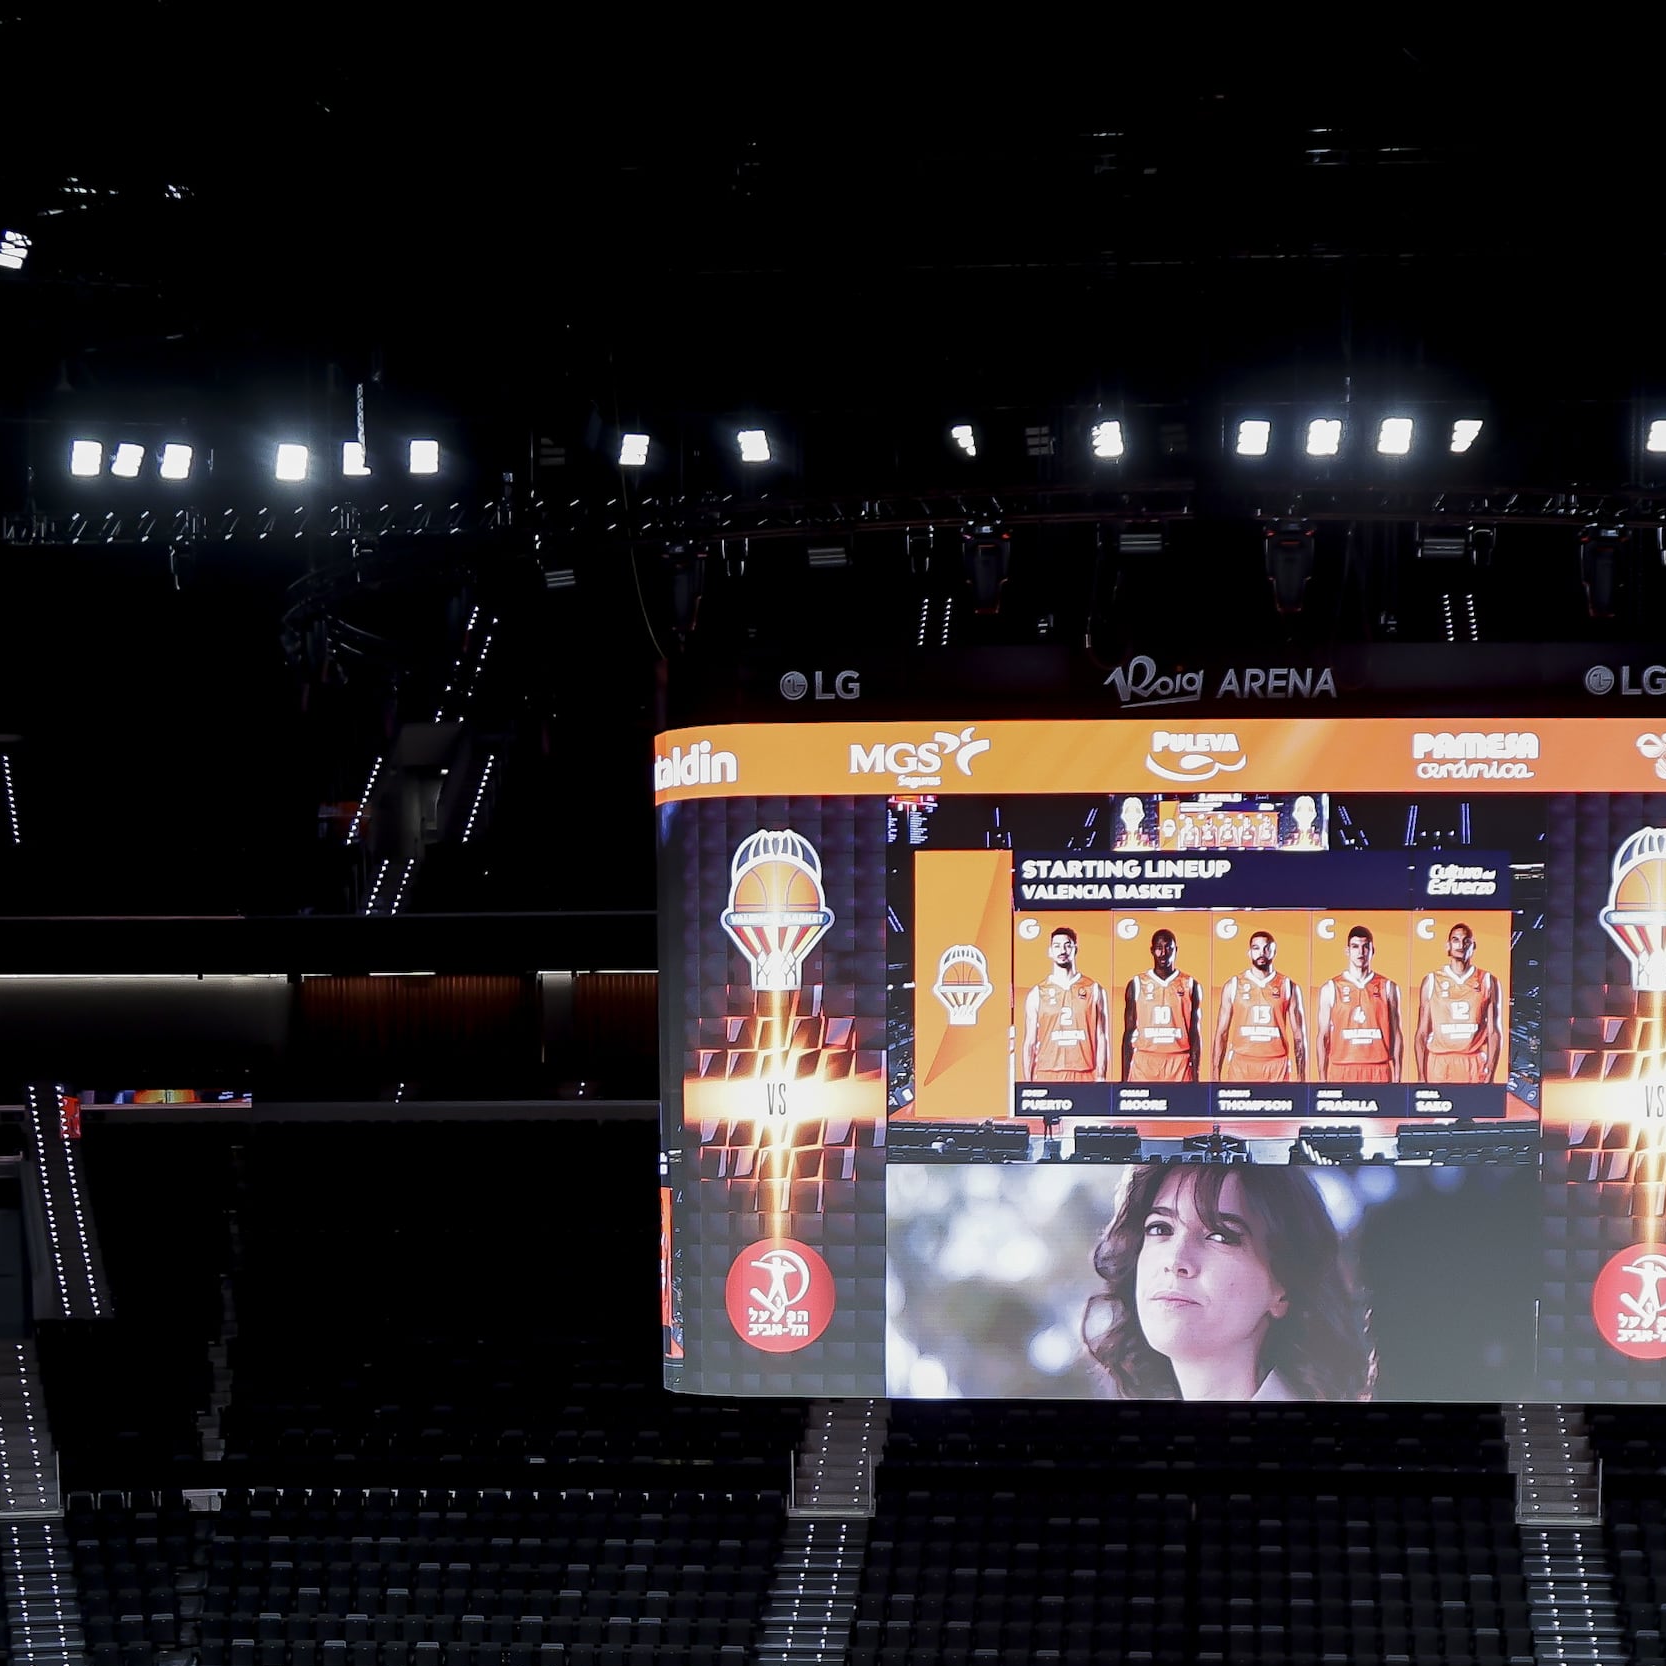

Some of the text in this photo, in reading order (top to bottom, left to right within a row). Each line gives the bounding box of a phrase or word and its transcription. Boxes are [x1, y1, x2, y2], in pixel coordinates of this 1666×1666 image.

[815, 670, 861, 700] LG
[1103, 655, 1337, 706] Roig ARENA
[1152, 731, 1240, 752] PULEVA
[1412, 732, 1539, 759] PAMESA
[849, 742, 942, 774] MGS
[1022, 859, 1231, 880] STARTING LINEUP
[1428, 864, 1483, 882] Cultura
[1021, 883, 1185, 901] VALENCIA BASKET
[1427, 880, 1497, 897] Esfuerzo
[1019, 918, 1040, 940] G
[1117, 918, 1139, 940] G
[1215, 918, 1238, 940] G
[1316, 918, 1335, 939] C
[1416, 917, 1435, 939] C
[1060, 1006, 1073, 1026] 2
[1153, 1006, 1172, 1025] 10
[1251, 1005, 1271, 1024] 13
[1351, 1005, 1366, 1024] 4
[1450, 1001, 1471, 1020] 12
[766, 1082, 787, 1116] VS
[1021, 1099, 1073, 1111] PUERTO
[1119, 1099, 1168, 1111] MOORE
[1218, 1099, 1293, 1111] THOMPSON
[1317, 1099, 1378, 1112] PRADILLA
[1415, 1100, 1453, 1112] SAKO
[1645, 1085, 1665, 1118] VS
